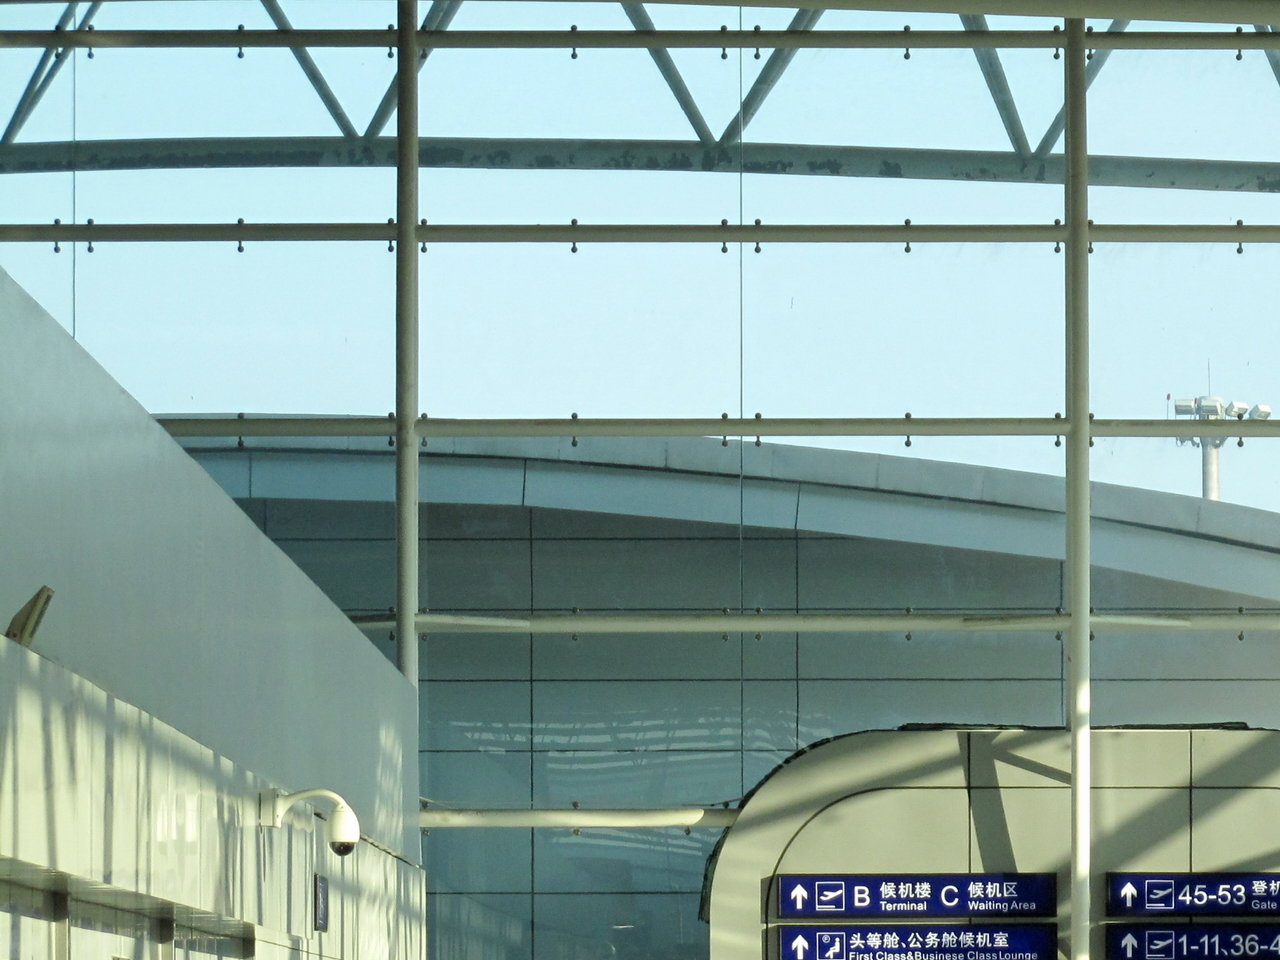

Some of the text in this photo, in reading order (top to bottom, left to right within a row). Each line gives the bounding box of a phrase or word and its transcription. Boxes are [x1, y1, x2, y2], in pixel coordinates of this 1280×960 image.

[854, 881, 1018, 907] B 候机楼 C 候机区
[1178, 884, 1246, 905] 45-53
[880, 901, 927, 911] Terminal
[968, 901, 1036, 912] Waiting Area
[1251, 900, 1278, 910] Gate
[849, 951, 874, 960] First
[967, 951, 998, 960] Class
